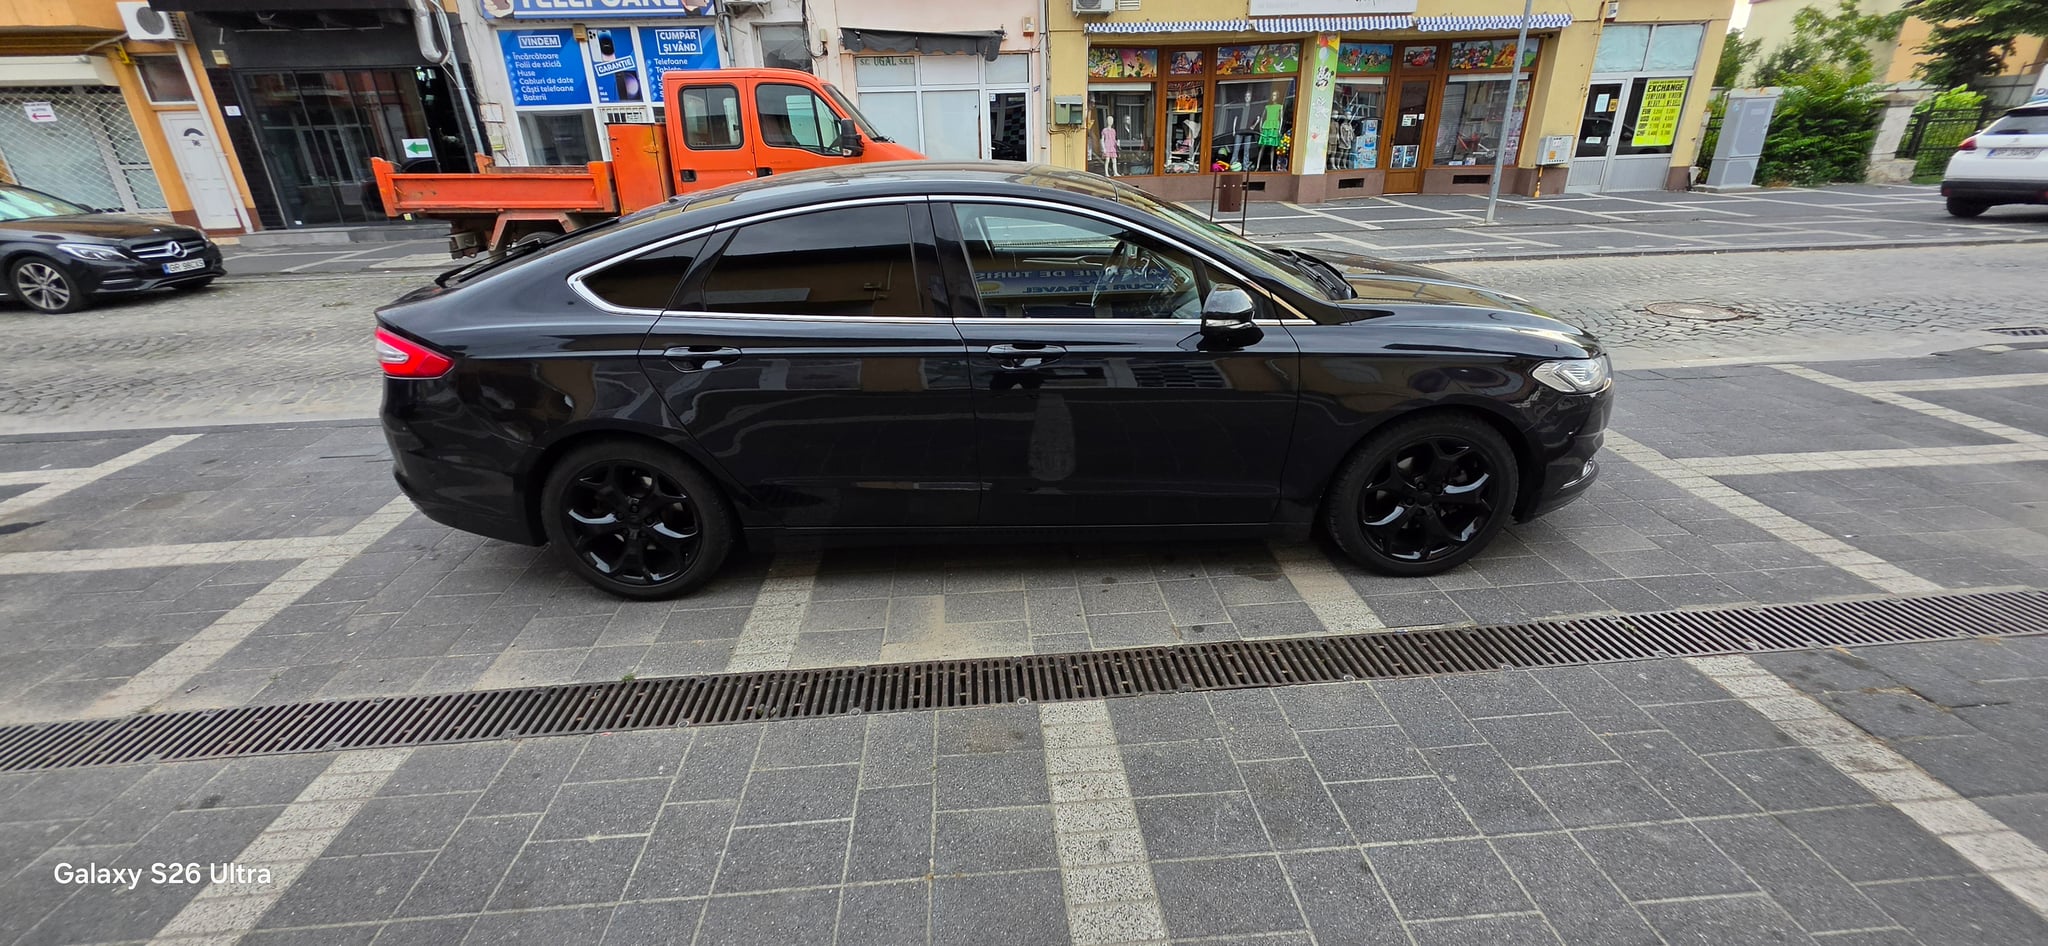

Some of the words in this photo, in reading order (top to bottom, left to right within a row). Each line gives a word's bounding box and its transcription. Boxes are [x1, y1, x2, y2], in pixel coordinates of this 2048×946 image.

[660, 30, 697, 40] CUMPĂR
[521, 37, 558, 46] VINDEM
[672, 41, 697, 52] VÂND
[512, 51, 559, 60] Încărcătoare
[542, 60, 562, 68] sticlă
[654, 57, 688, 65] Telefoane
[540, 85, 574, 93] telefoane
[1648, 83, 1684, 92] EXCHANGE
[523, 93, 547, 101] Baterii
